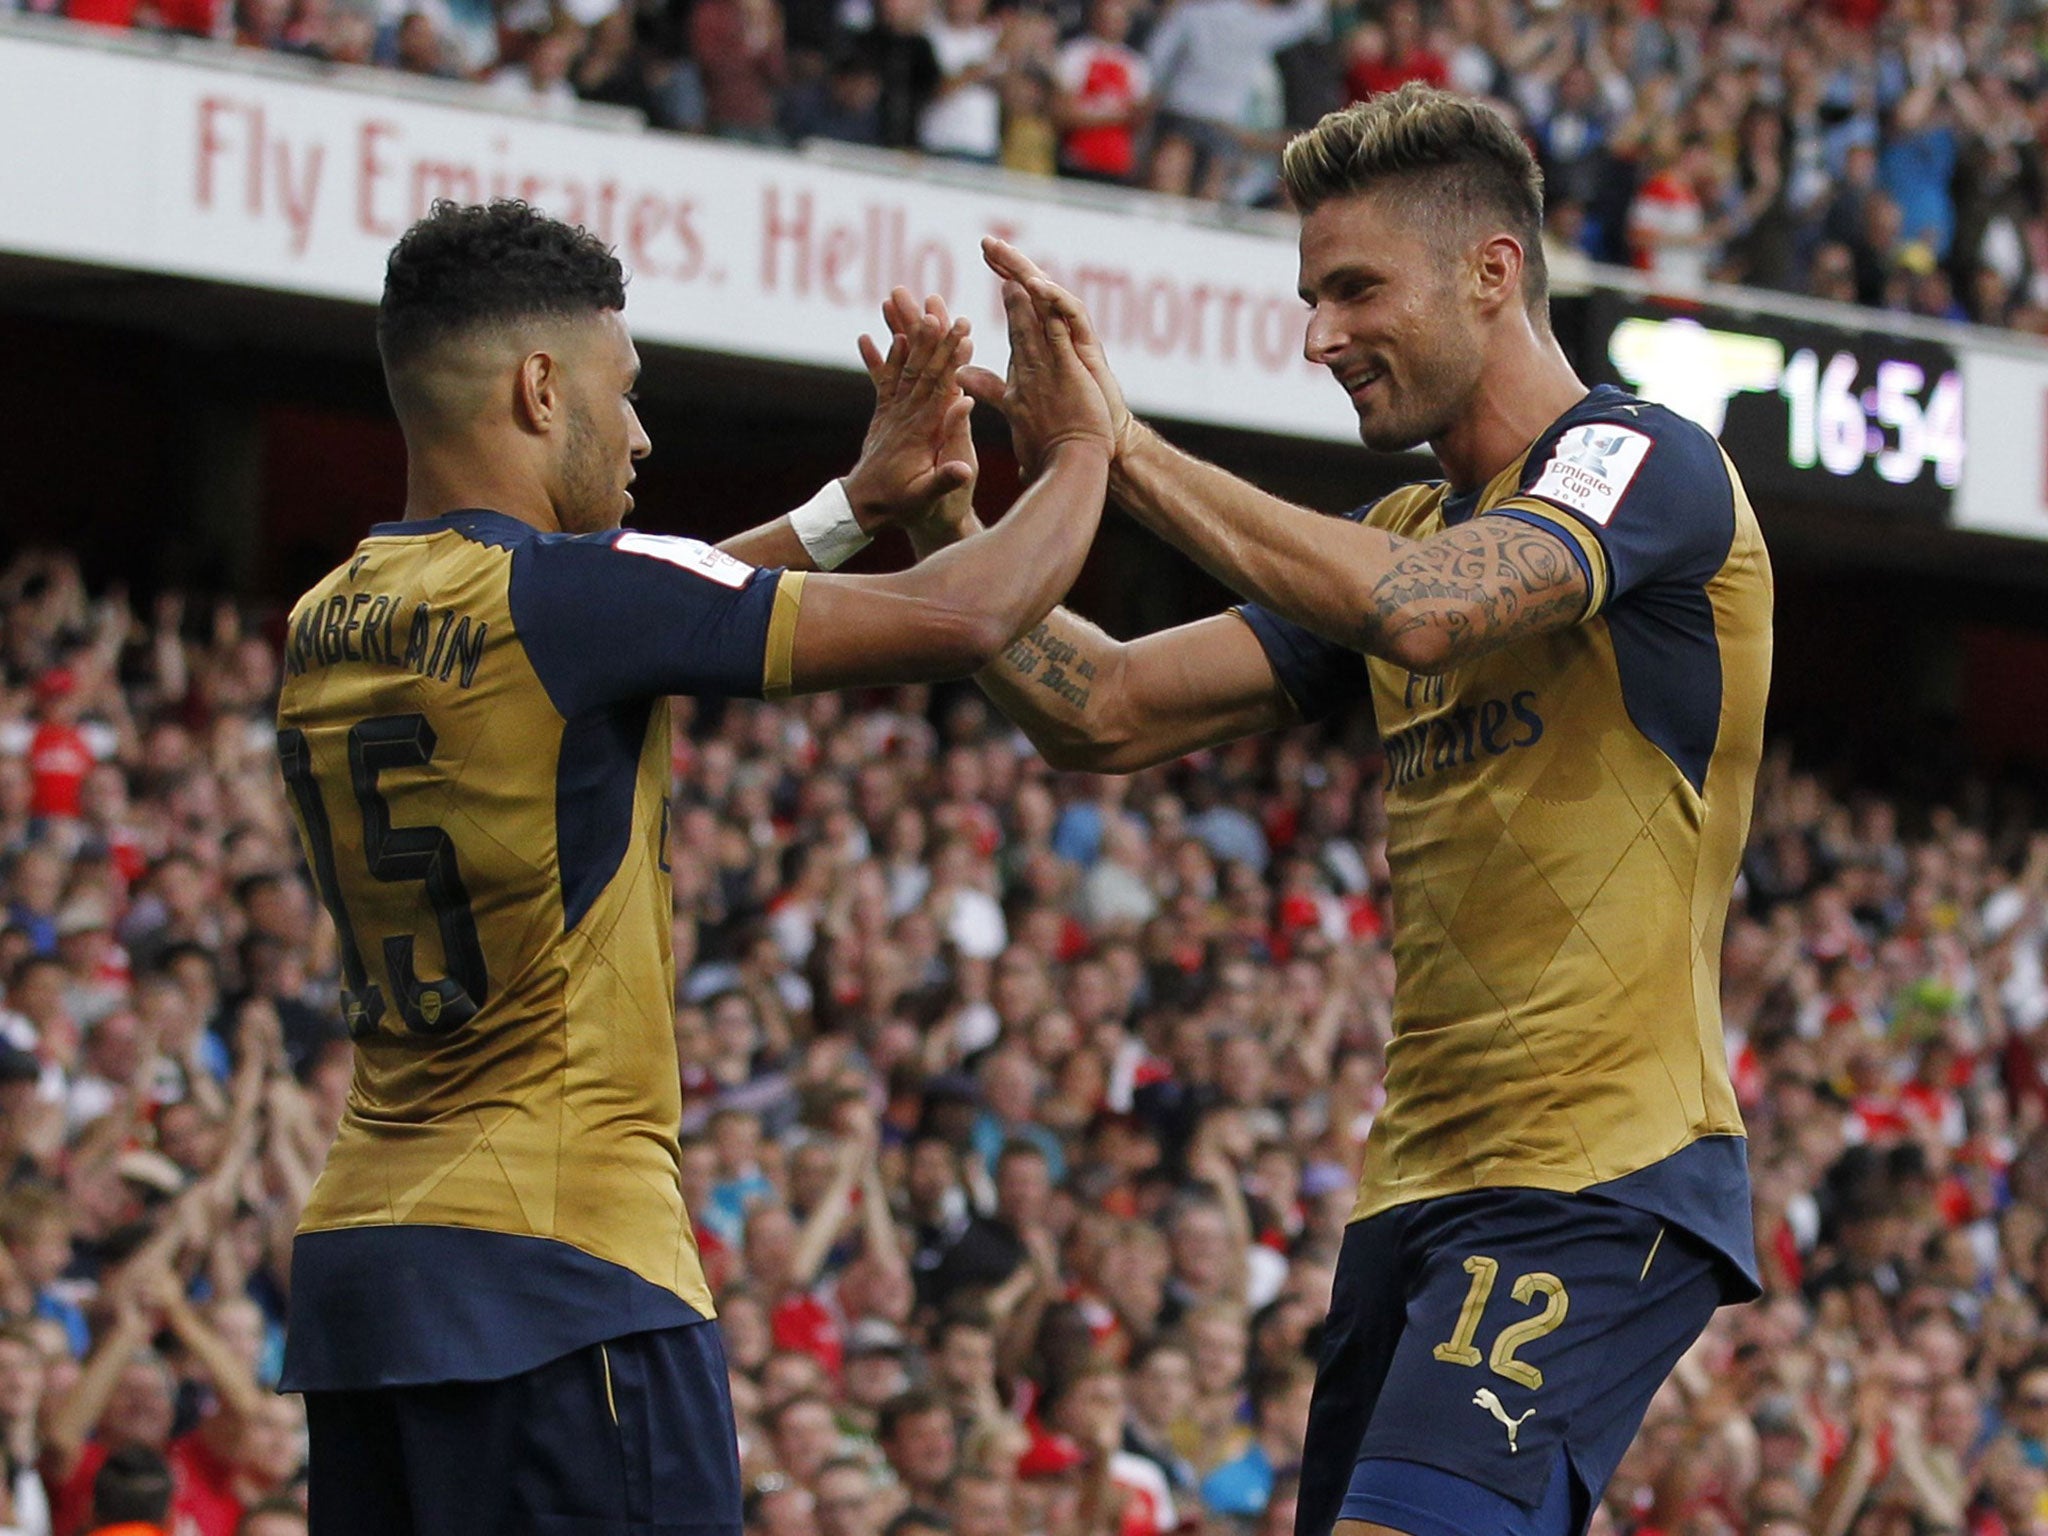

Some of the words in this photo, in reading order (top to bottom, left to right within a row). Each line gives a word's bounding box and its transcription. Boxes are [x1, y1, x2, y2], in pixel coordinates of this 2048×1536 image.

[195, 94, 325, 256] Fly
[760, 182, 957, 308] Hello
[1551, 461, 1614, 497] Emirates
[1561, 476, 1592, 499] Cup
[1779, 347, 1965, 489] 16:54
[278, 712, 489, 1038] 15
[1432, 1254, 1570, 1391] 12
